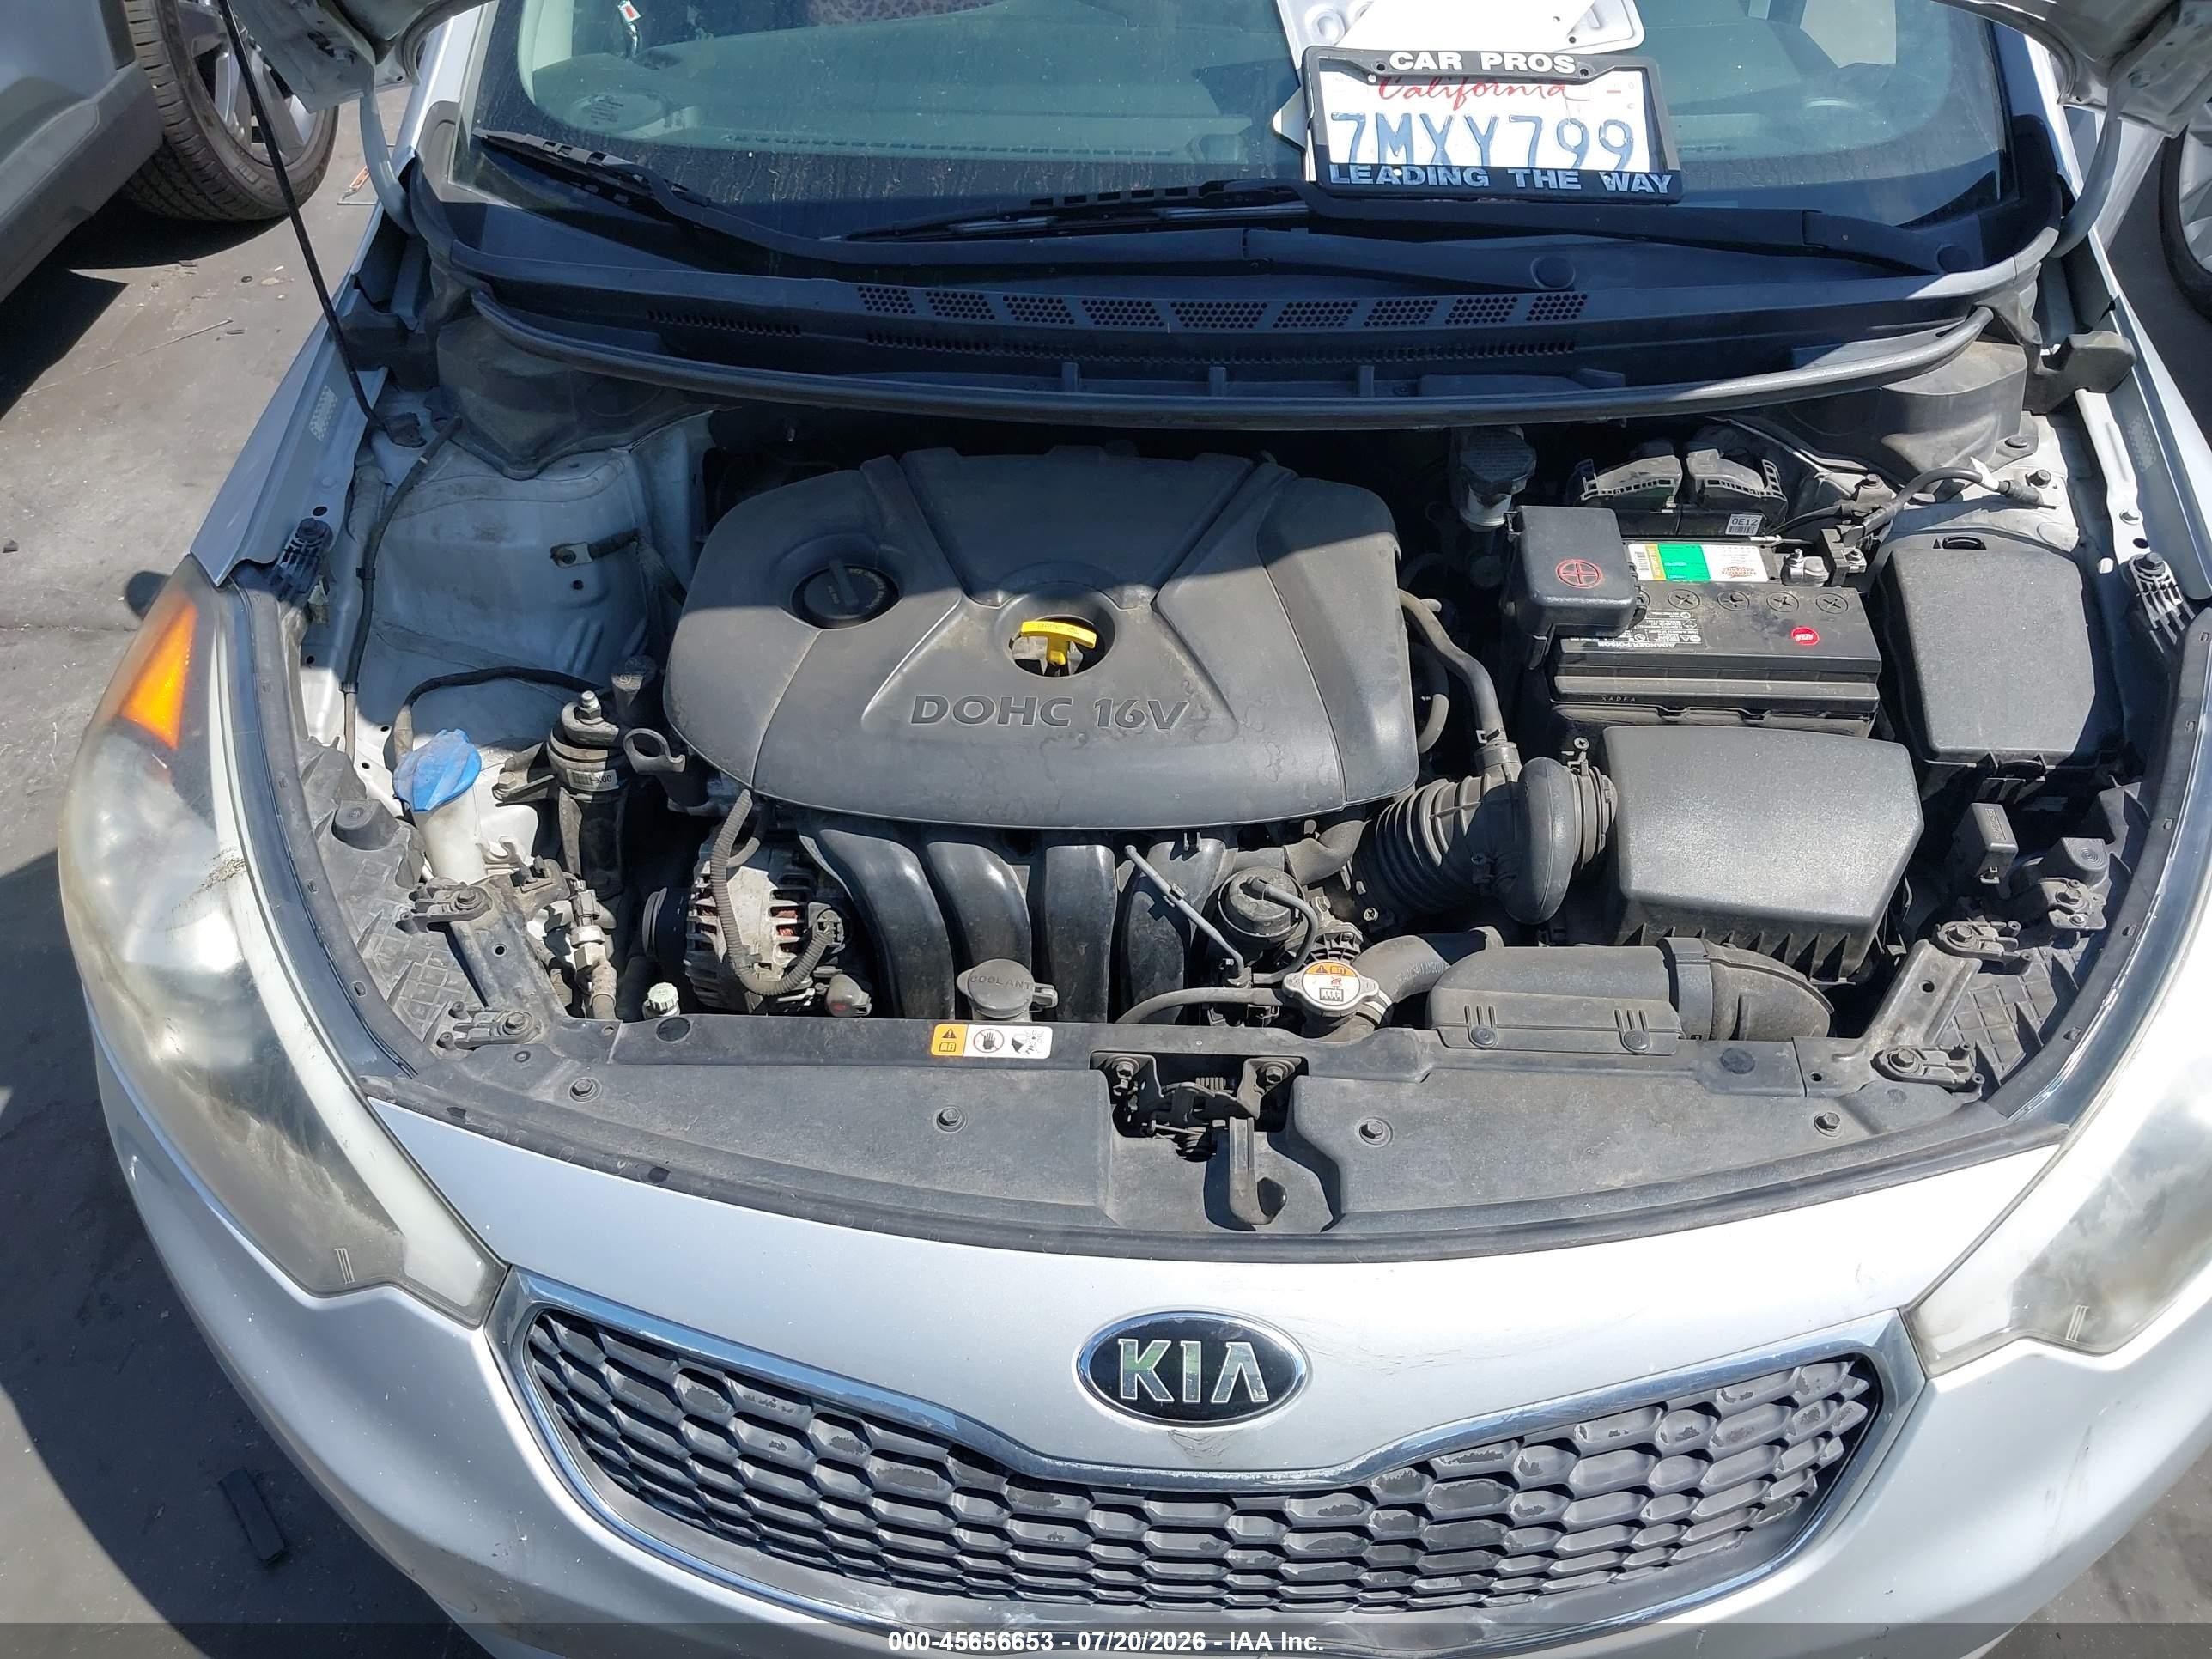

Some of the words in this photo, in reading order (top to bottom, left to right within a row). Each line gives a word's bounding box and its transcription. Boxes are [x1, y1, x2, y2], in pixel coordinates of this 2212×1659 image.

[1389, 52, 1464, 71] CAR
[1480, 52, 1577, 75] PROS
[1377, 76, 1566, 111] California
[1331, 112, 1634, 172] 7MXY799
[1329, 164, 1491, 188] LEADING
[1507, 169, 1582, 191] THE
[1599, 172, 1674, 195] WAY
[910, 694, 1073, 727] DOHC
[1093, 697, 1189, 730] 16V
[969, 975, 1033, 990] COOLANT
[1118, 1338, 1269, 1403] KIA
